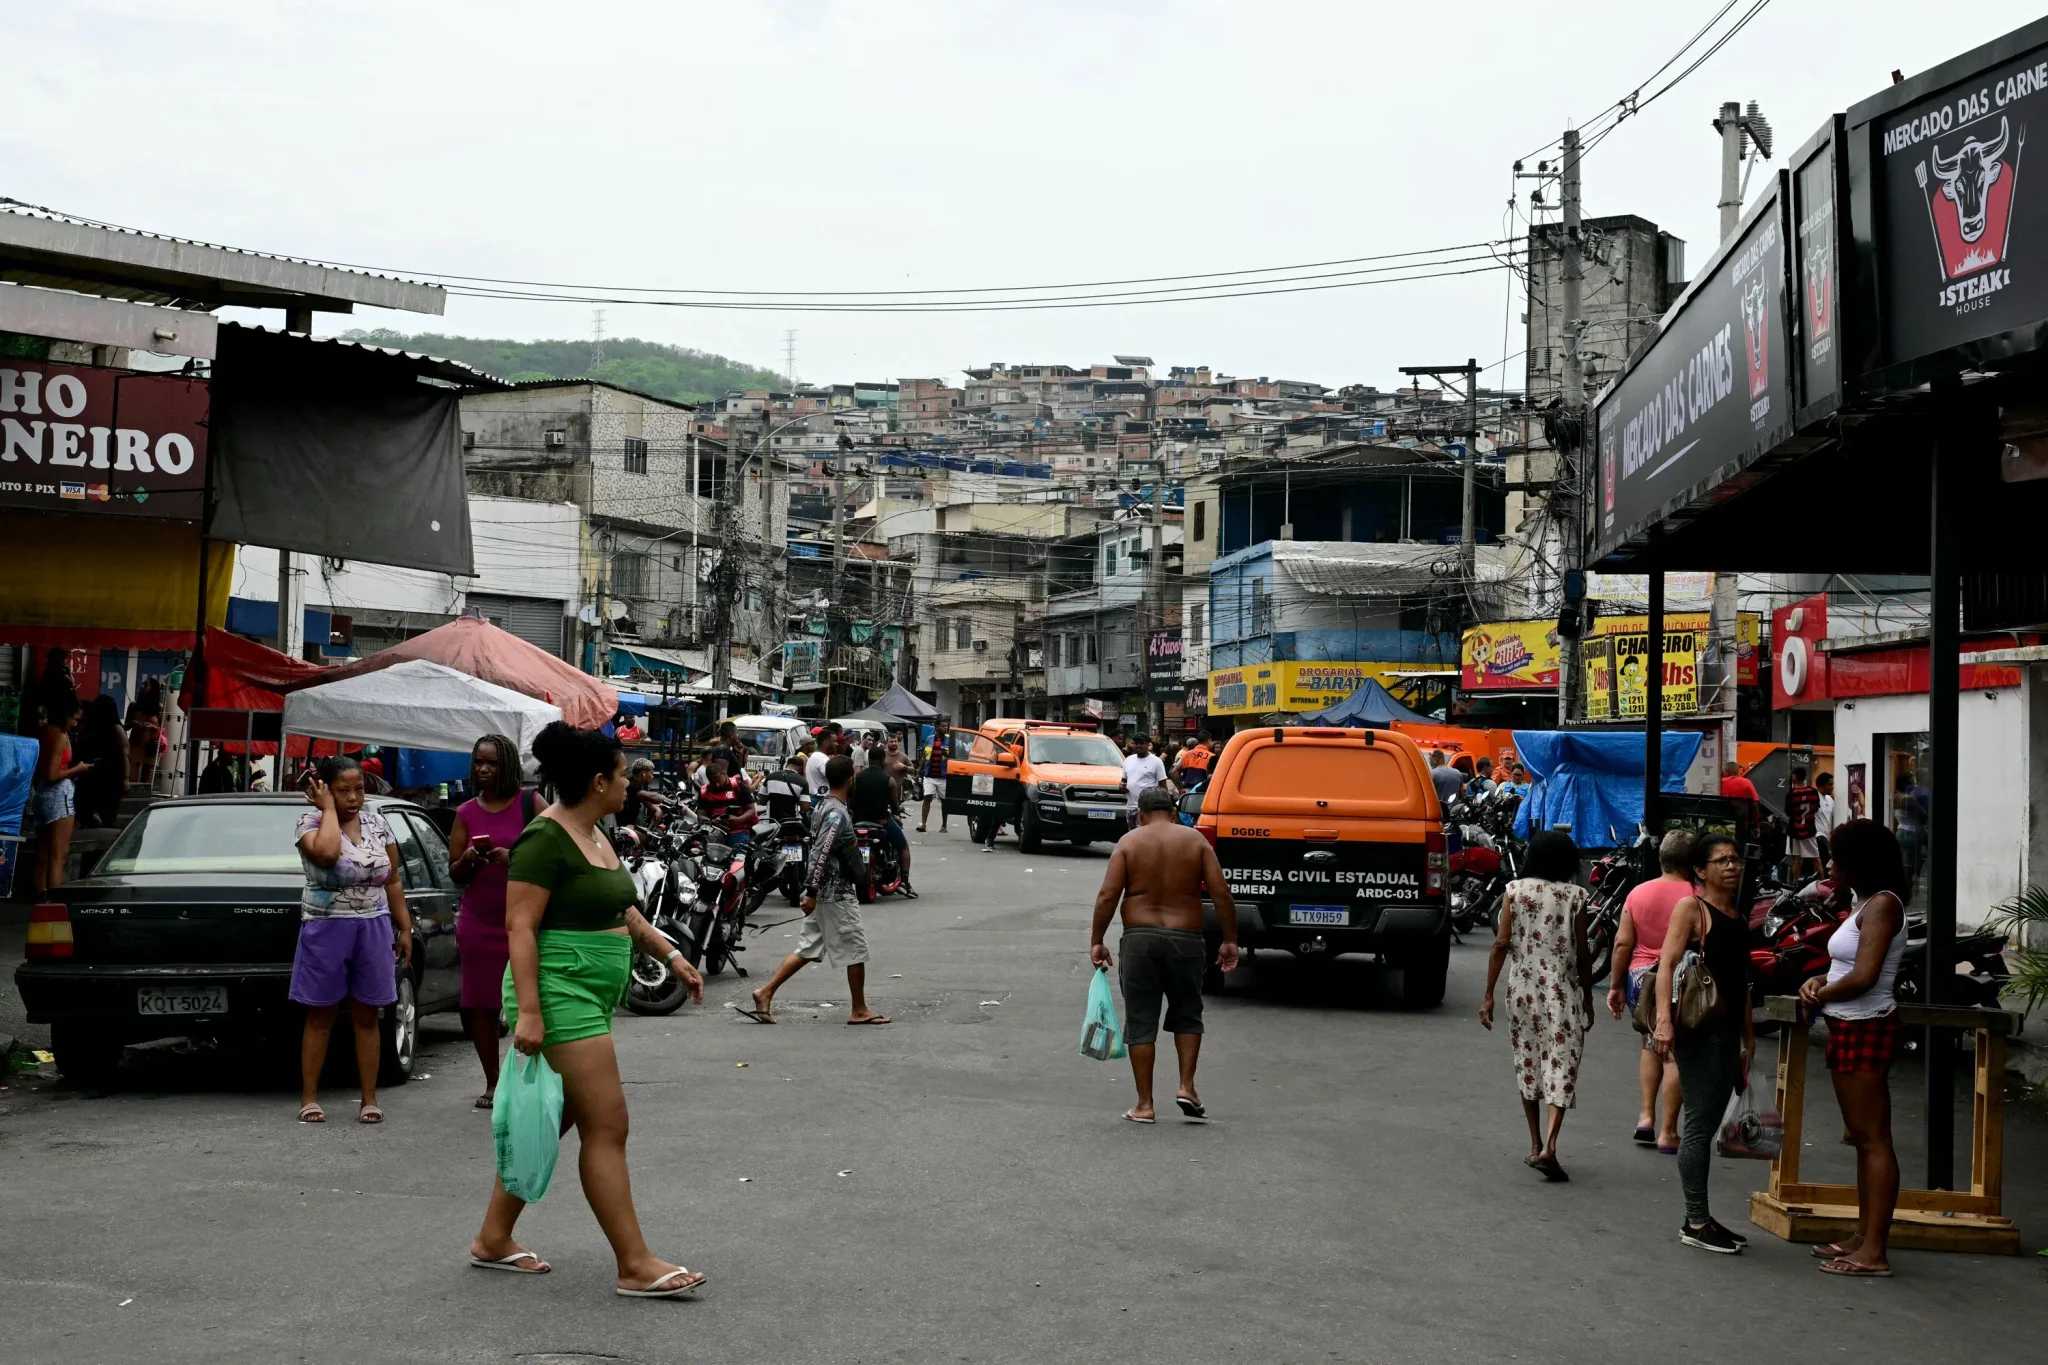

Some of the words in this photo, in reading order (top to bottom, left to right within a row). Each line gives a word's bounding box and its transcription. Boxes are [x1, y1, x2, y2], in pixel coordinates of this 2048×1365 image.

[1884, 105, 1953, 156] MERCADO
[1958, 88, 1989, 124] DAS
[1956, 295, 1991, 316] HOUSE
[1623, 392, 1662, 481] MERCADO
[1665, 369, 1686, 445] DAS
[1688, 322, 1733, 425] CARNES
[1, 418, 195, 475] NEIRO
[25, 484, 32, 493] E
[36, 484, 56, 494] PIX
[65, 486, 81, 494] VISA
[1617, 635, 1692, 656] CHAEIRO
[1299, 667, 1363, 676] DROGARIAS
[967, 799, 997, 808] ARDC-032
[1800, 803, 1810, 824] 7
[1231, 827, 1270, 837] DGDEC
[822, 826, 837, 854] AMIGOS
[818, 853, 828, 864] DA
[1222, 868, 1283, 882] DEFESA
[1287, 870, 1330, 883] CIVIL
[1335, 871, 1419, 886] ESTADUAL
[1356, 888, 1419, 899] ARDC-031
[1295, 911, 1343, 924] LTX9H59
